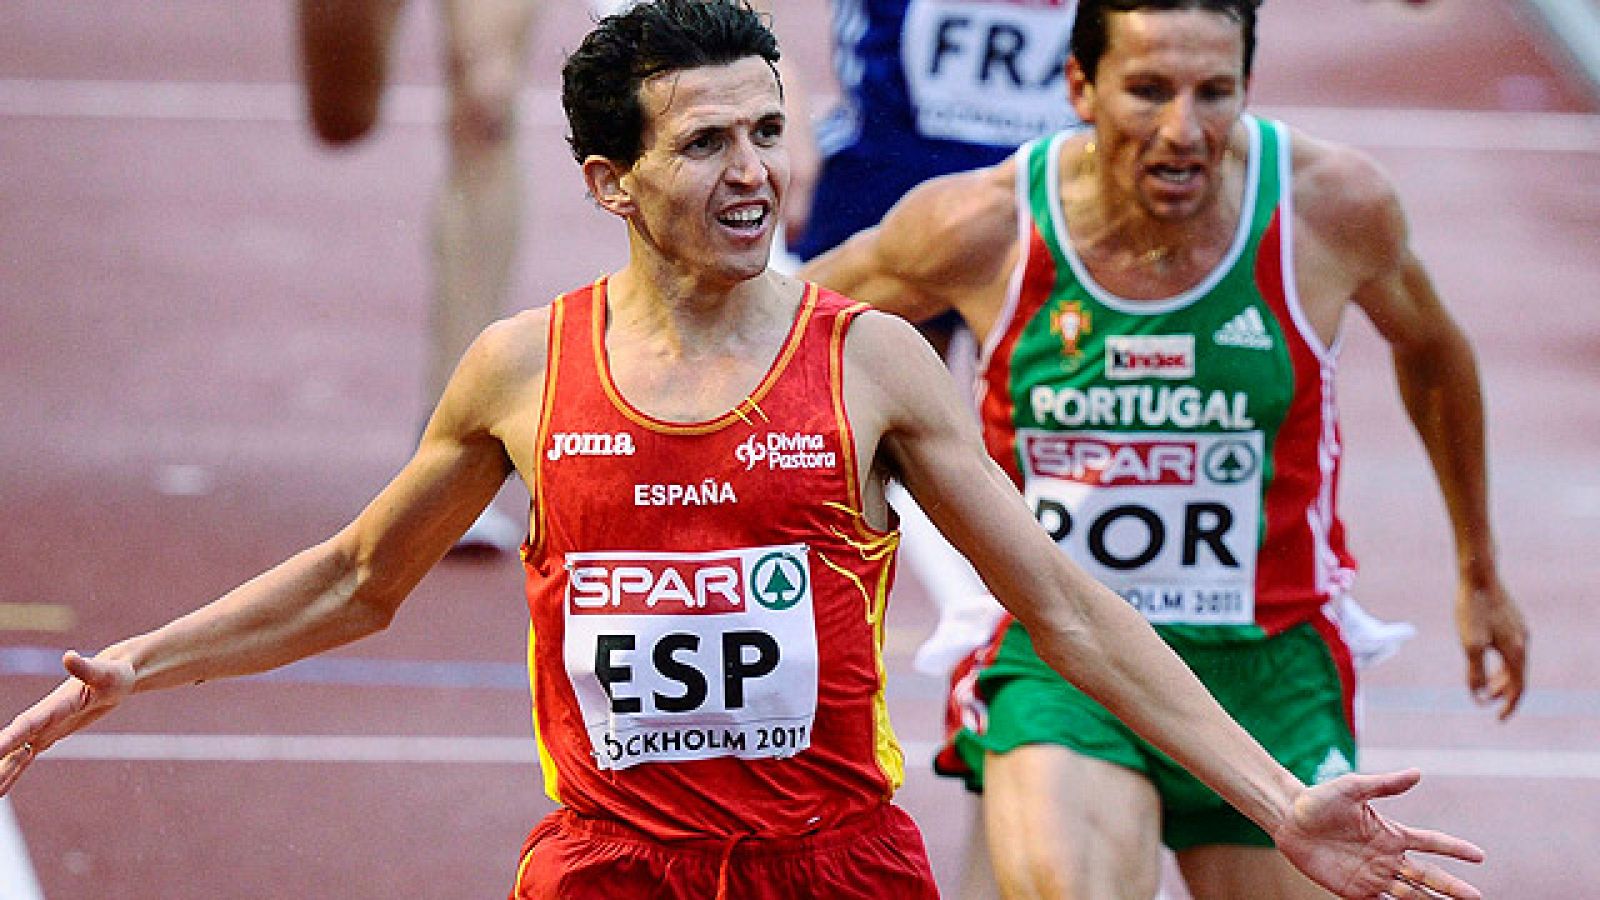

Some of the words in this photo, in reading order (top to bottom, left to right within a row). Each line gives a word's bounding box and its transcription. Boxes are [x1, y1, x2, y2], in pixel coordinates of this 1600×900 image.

[1029, 385, 1255, 430] PORTUGAL
[766, 432, 825, 451] Divina
[769, 451, 837, 470] Pastora
[1031, 439, 1192, 481] SPAR
[634, 478, 738, 506] ESPAÑA
[1035, 499, 1241, 571] POR
[572, 566, 742, 609] SPAR
[594, 631, 781, 713] ESP
[604, 729, 746, 760] OCKHOLM
